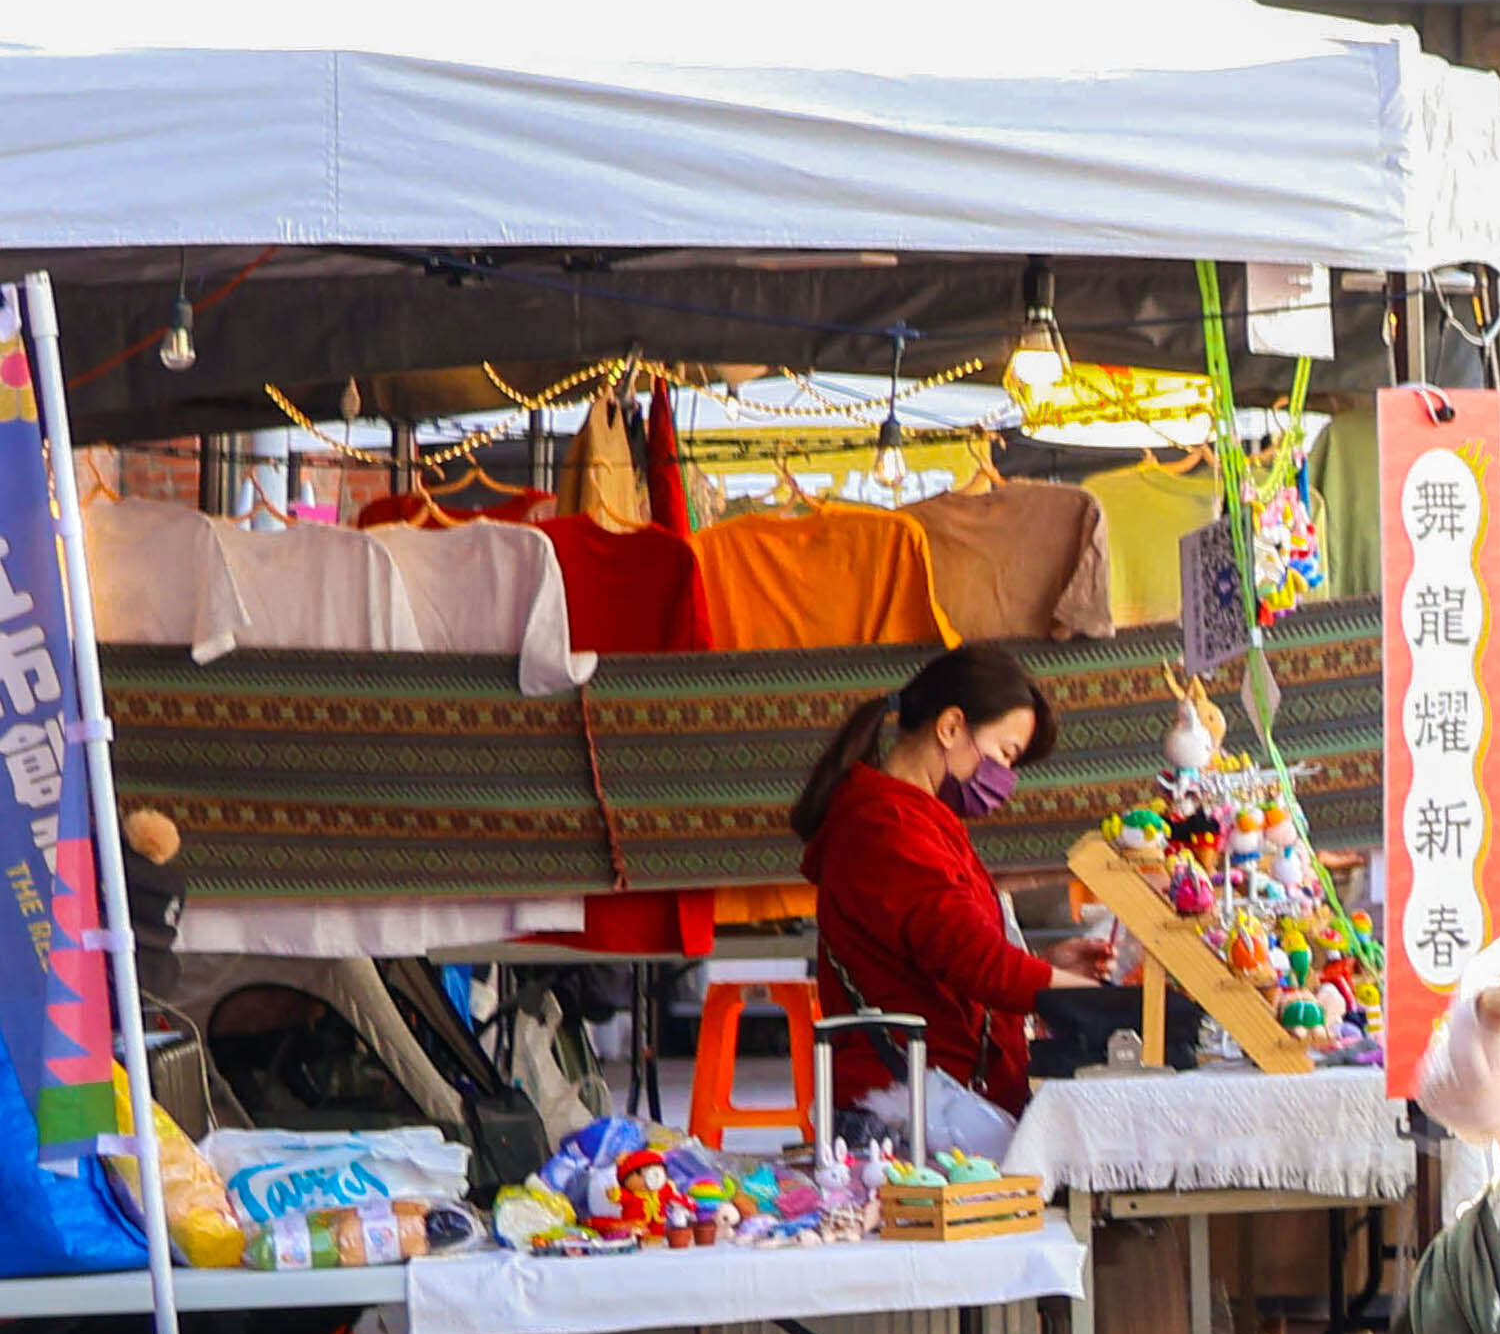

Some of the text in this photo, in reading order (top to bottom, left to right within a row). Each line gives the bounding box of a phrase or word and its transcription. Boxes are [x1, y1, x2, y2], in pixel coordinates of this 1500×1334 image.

[1410, 479, 1473, 969] 舞龍耀新春
[6, 859, 46, 917] THE
